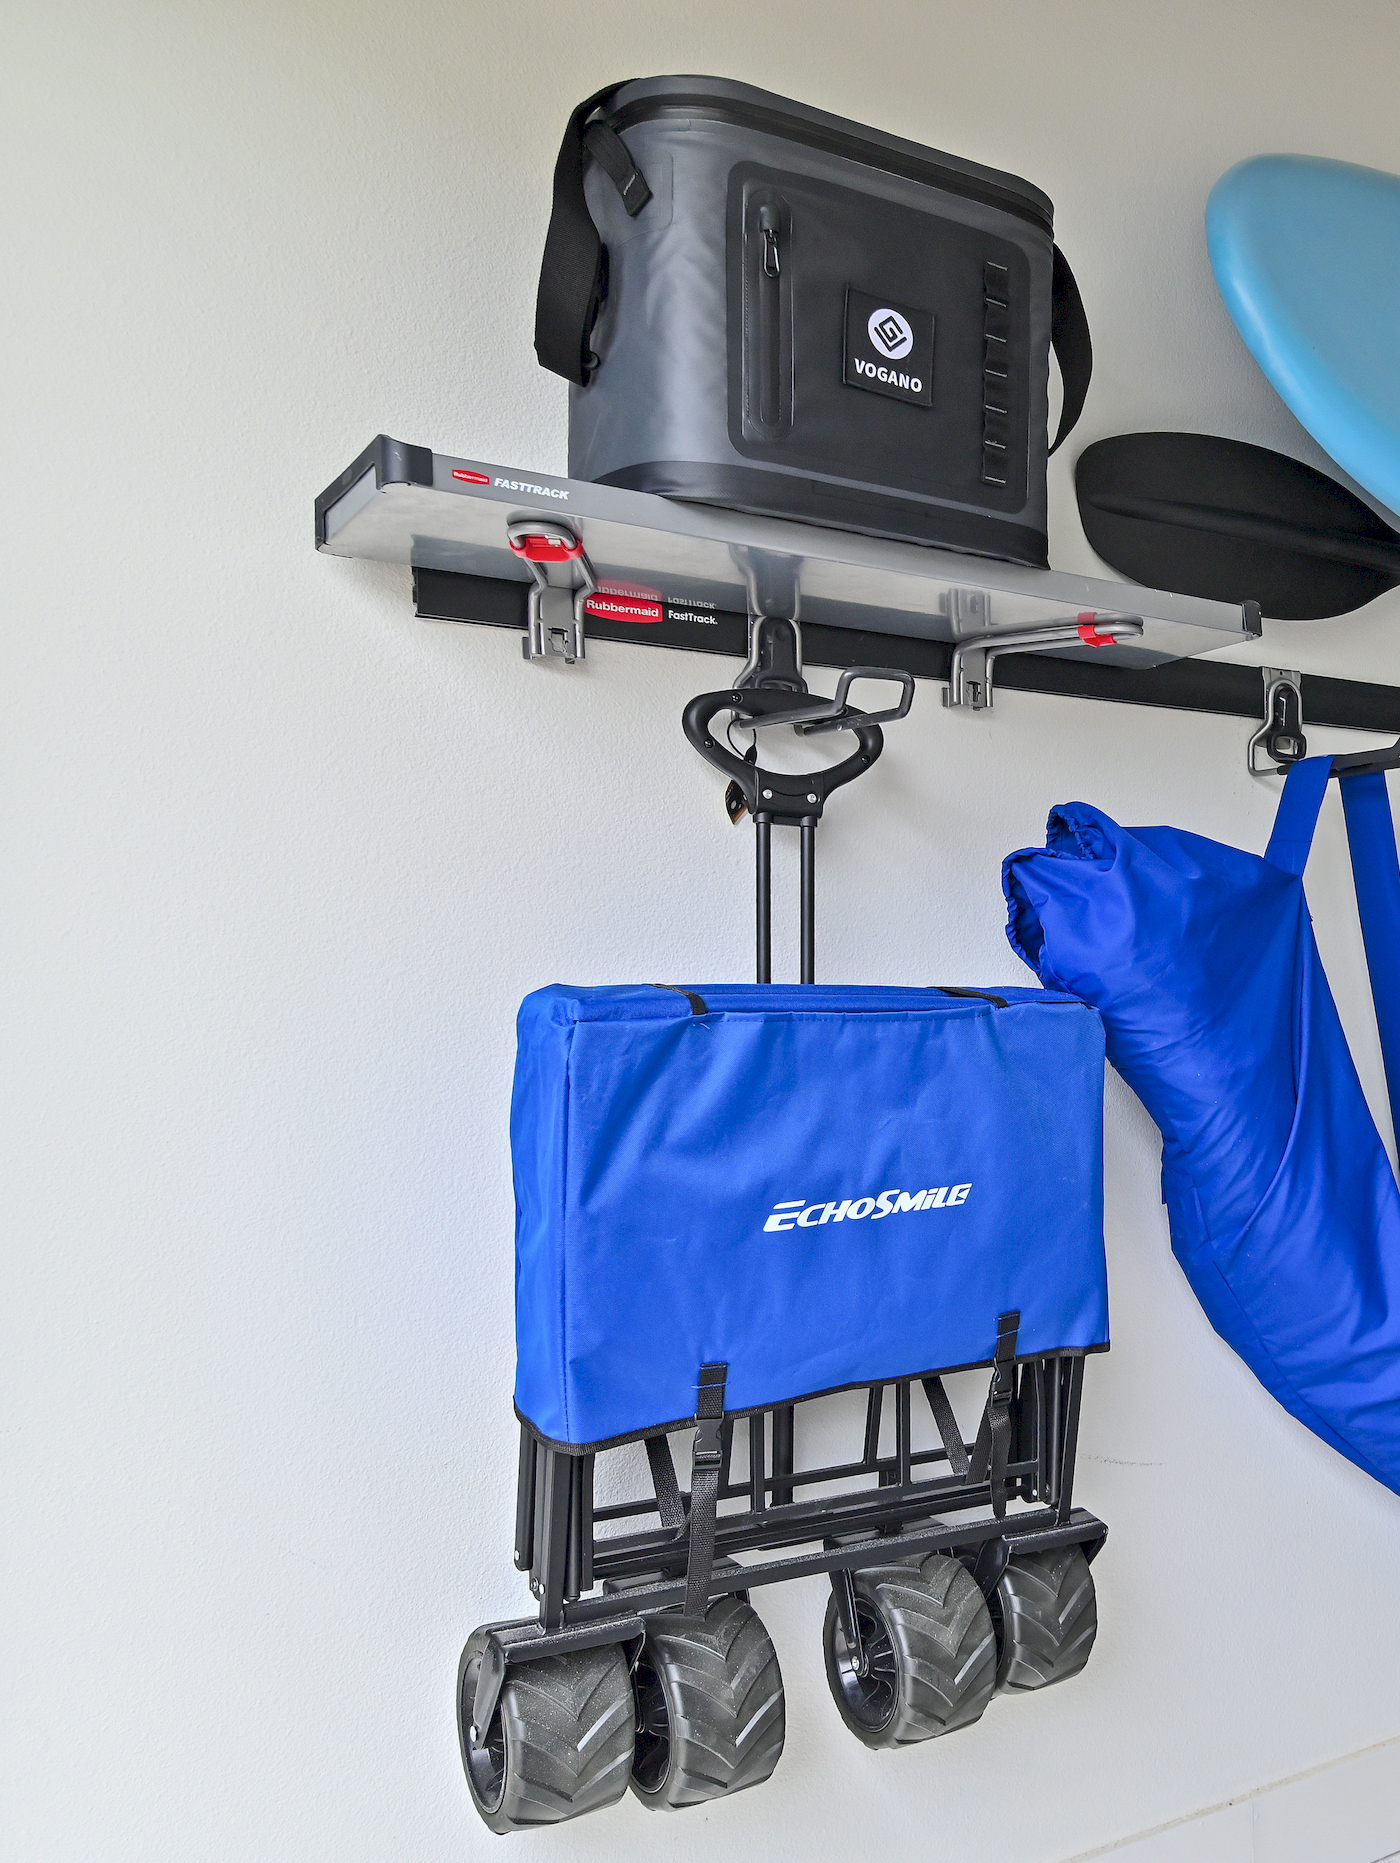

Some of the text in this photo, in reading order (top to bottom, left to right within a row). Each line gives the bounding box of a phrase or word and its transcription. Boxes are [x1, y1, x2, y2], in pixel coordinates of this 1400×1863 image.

[854, 357, 923, 393] VOGANO
[494, 477, 570, 500] FASTTRACK
[586, 599, 659, 617] Rubbermaid
